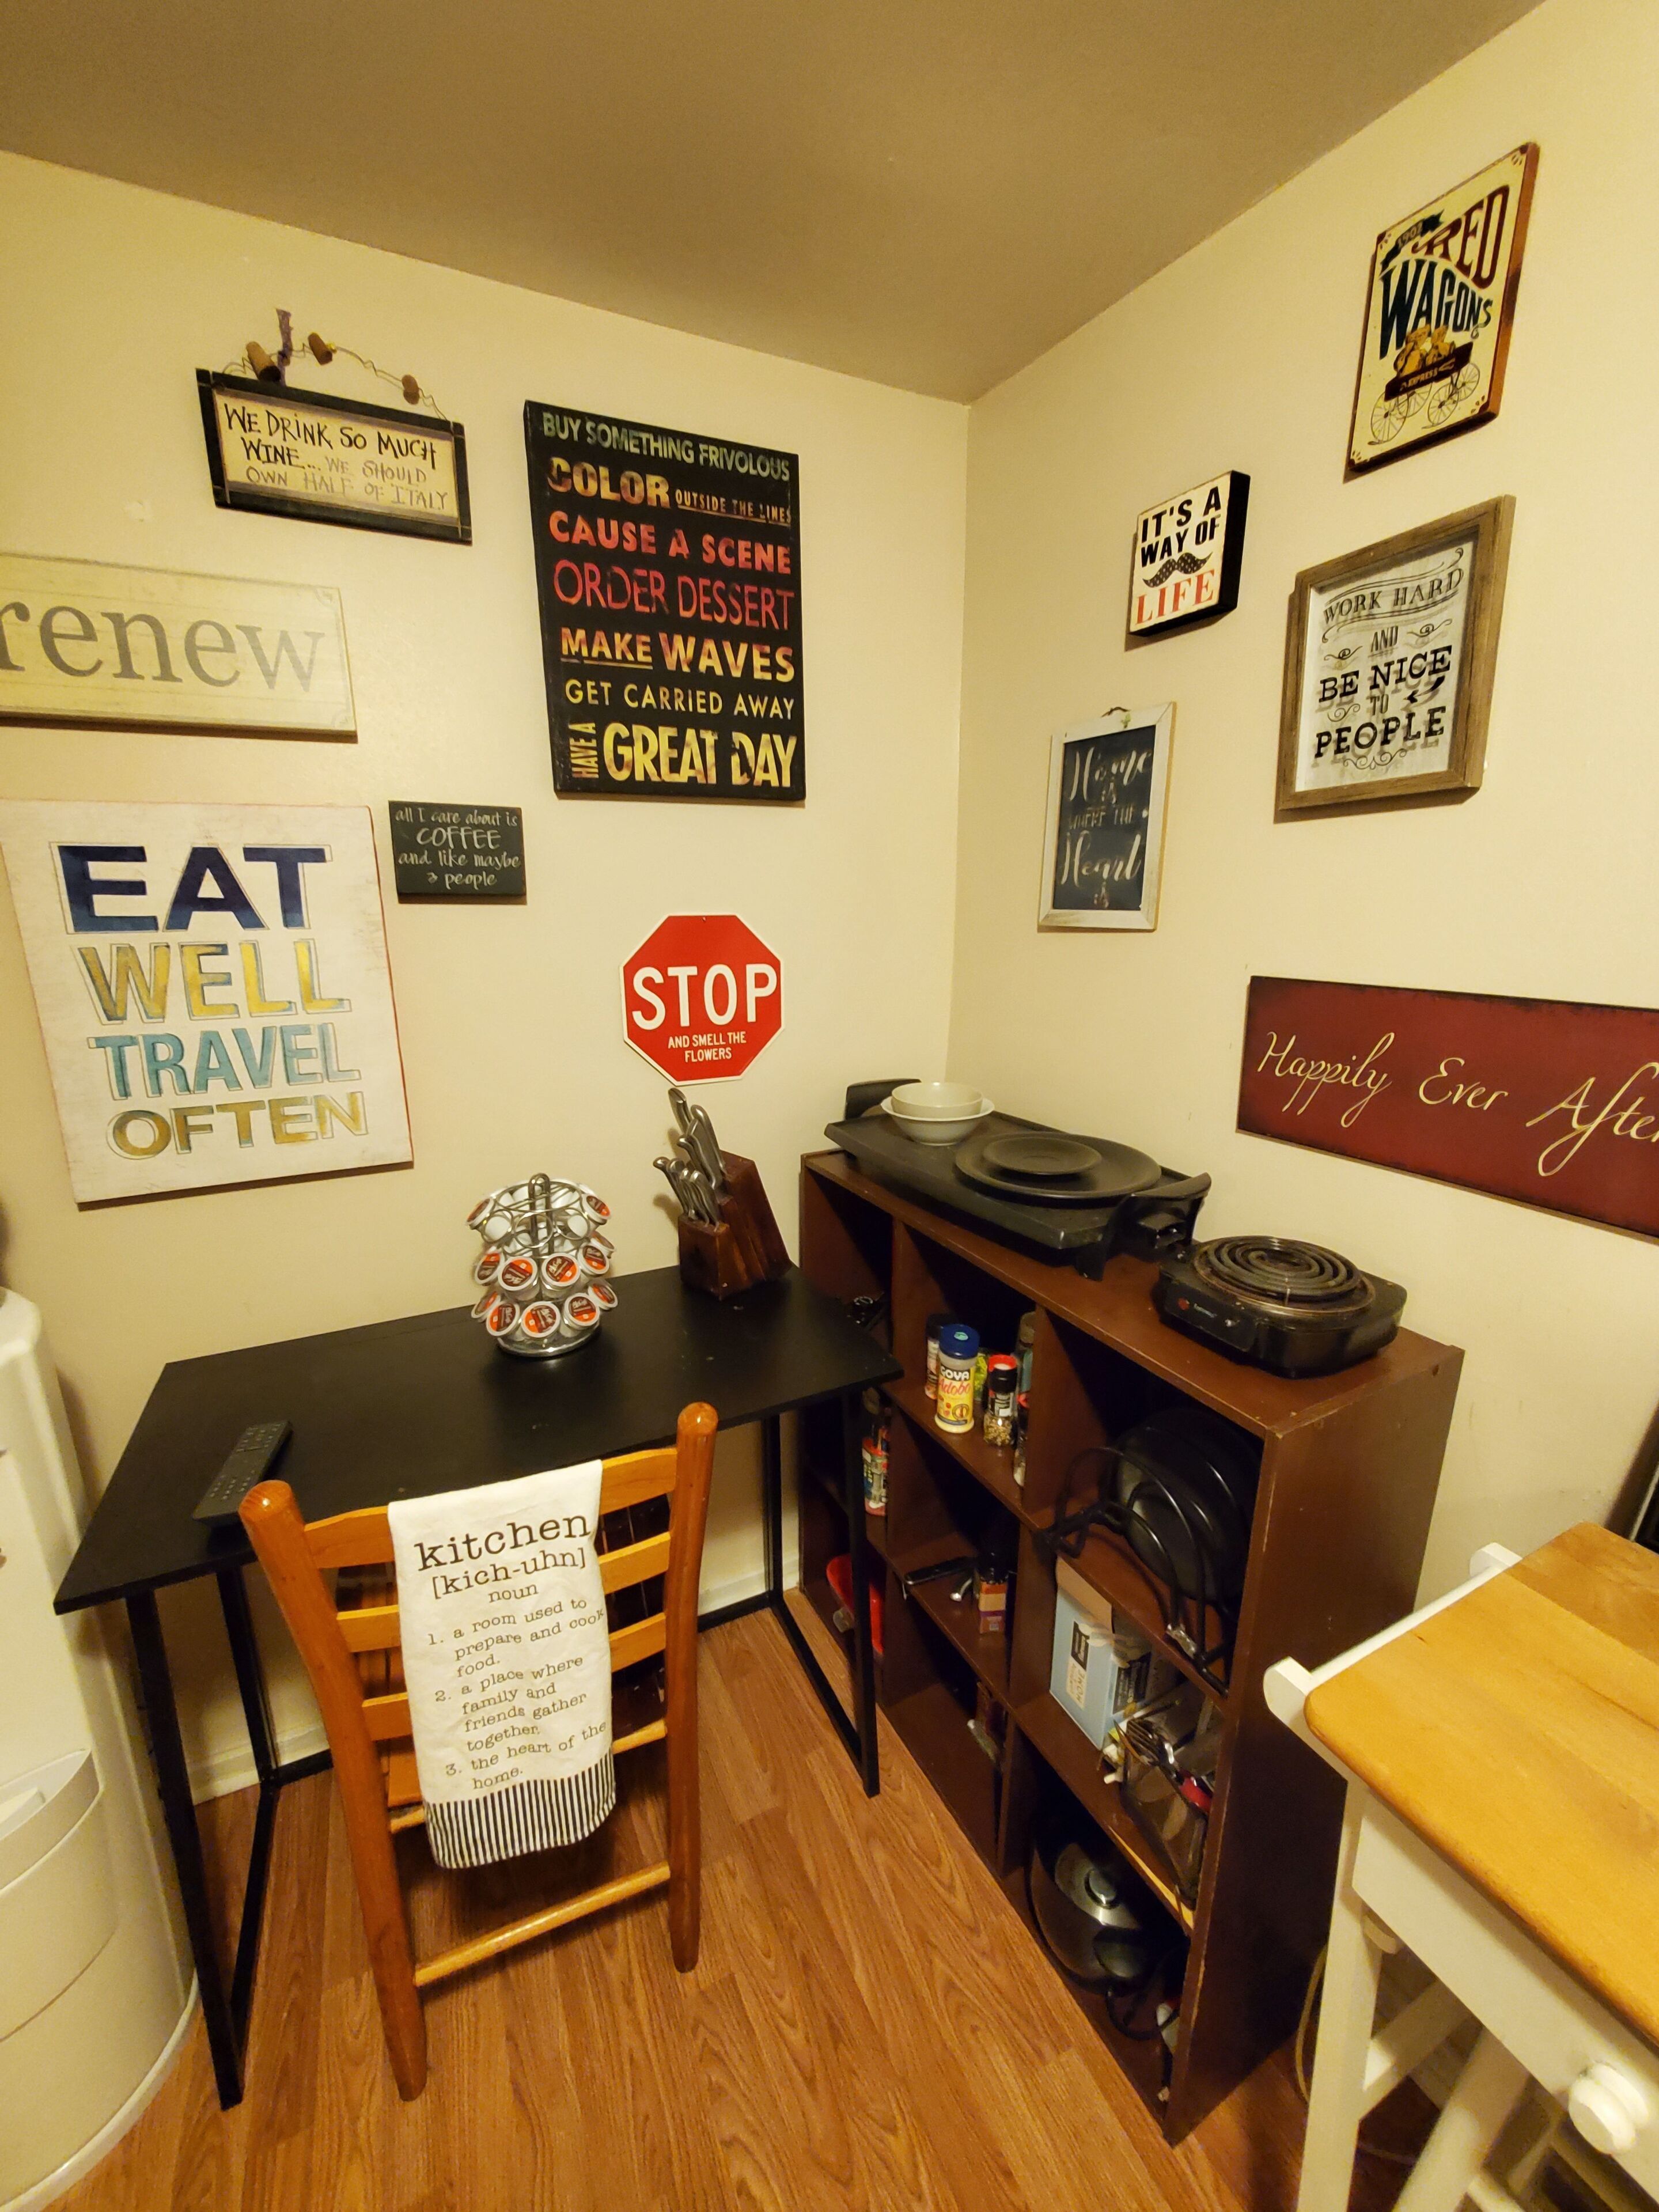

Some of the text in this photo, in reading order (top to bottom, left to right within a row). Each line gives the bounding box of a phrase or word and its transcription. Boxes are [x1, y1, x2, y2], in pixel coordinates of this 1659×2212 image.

[1411, 185, 1510, 289] RED
[1380, 257, 1493, 360] WAGONS
[224, 403, 262, 434] WE
[340, 427, 367, 450] SO
[378, 431, 436, 469] MUCH
[543, 412, 790, 482] BUY SOMETHING FRIVOLOUS
[246, 465, 448, 510] OWN HALF OF ITALY
[324, 456, 350, 475] WE
[362, 461, 427, 487] SHOULD
[547, 457, 791, 525] COLOR OUTSIDE THE LINES
[1141, 486, 1221, 543] IT'S A
[1141, 514, 1221, 568] WAY OF
[549, 510, 792, 575] CAUSE A SCENE
[553, 559, 795, 631] ORDER DESSERT
[1135, 569, 1214, 626] LIFE
[1323, 568, 1464, 624] WORK HARD
[0, 602, 325, 692] renew
[560, 627, 796, 683] MAKE WAVES
[1370, 626, 1399, 653] AND
[565, 679, 794, 721] GET CARRIED AWAY
[1319, 645, 1452, 703] BE NICE
[1370, 694, 1389, 715] TO
[568, 722, 599, 779] HAVE A
[603, 722, 797, 788] GREAT DAY
[1315, 706, 1446, 758] PEOPLE
[1070, 747, 1151, 801] Home
[395, 807, 518, 826] all I care about is
[416, 826, 501, 849] COFFEE
[398, 849, 521, 870] and like maybe
[445, 871, 497, 889] people
[56, 844, 328, 933] EAT
[75, 940, 350, 1024] WELL
[632, 963, 777, 1030] STOP
[89, 1023, 361, 1100] TRAVEL
[668, 1031, 747, 1048] AND SMELL THE
[684, 1047, 732, 1062] FLOWERS
[1257, 1032, 1395, 1128] Happily
[1419, 1057, 1508, 1111] Ever
[107, 1092, 369, 1159] OFTEN
[940, 1365, 969, 1381] GOYA
[414, 1515, 591, 1571] kitchen
[433, 1548, 586, 1600] [kich-uhn]
[488, 1584, 539, 1603] noun
[428, 1599, 587, 1646] 1. a room used to
[454, 1609, 604, 1661] prepare and cook
[434, 1657, 583, 1702] 2. a place where
[457, 1654, 501, 1677] food.
[463, 1682, 557, 1715] family and
[465, 1693, 587, 1732] friends gather
[445, 1722, 607, 1776] 3. the heart of the
[467, 1725, 540, 1751] together.
[472, 1767, 523, 1789] home.
